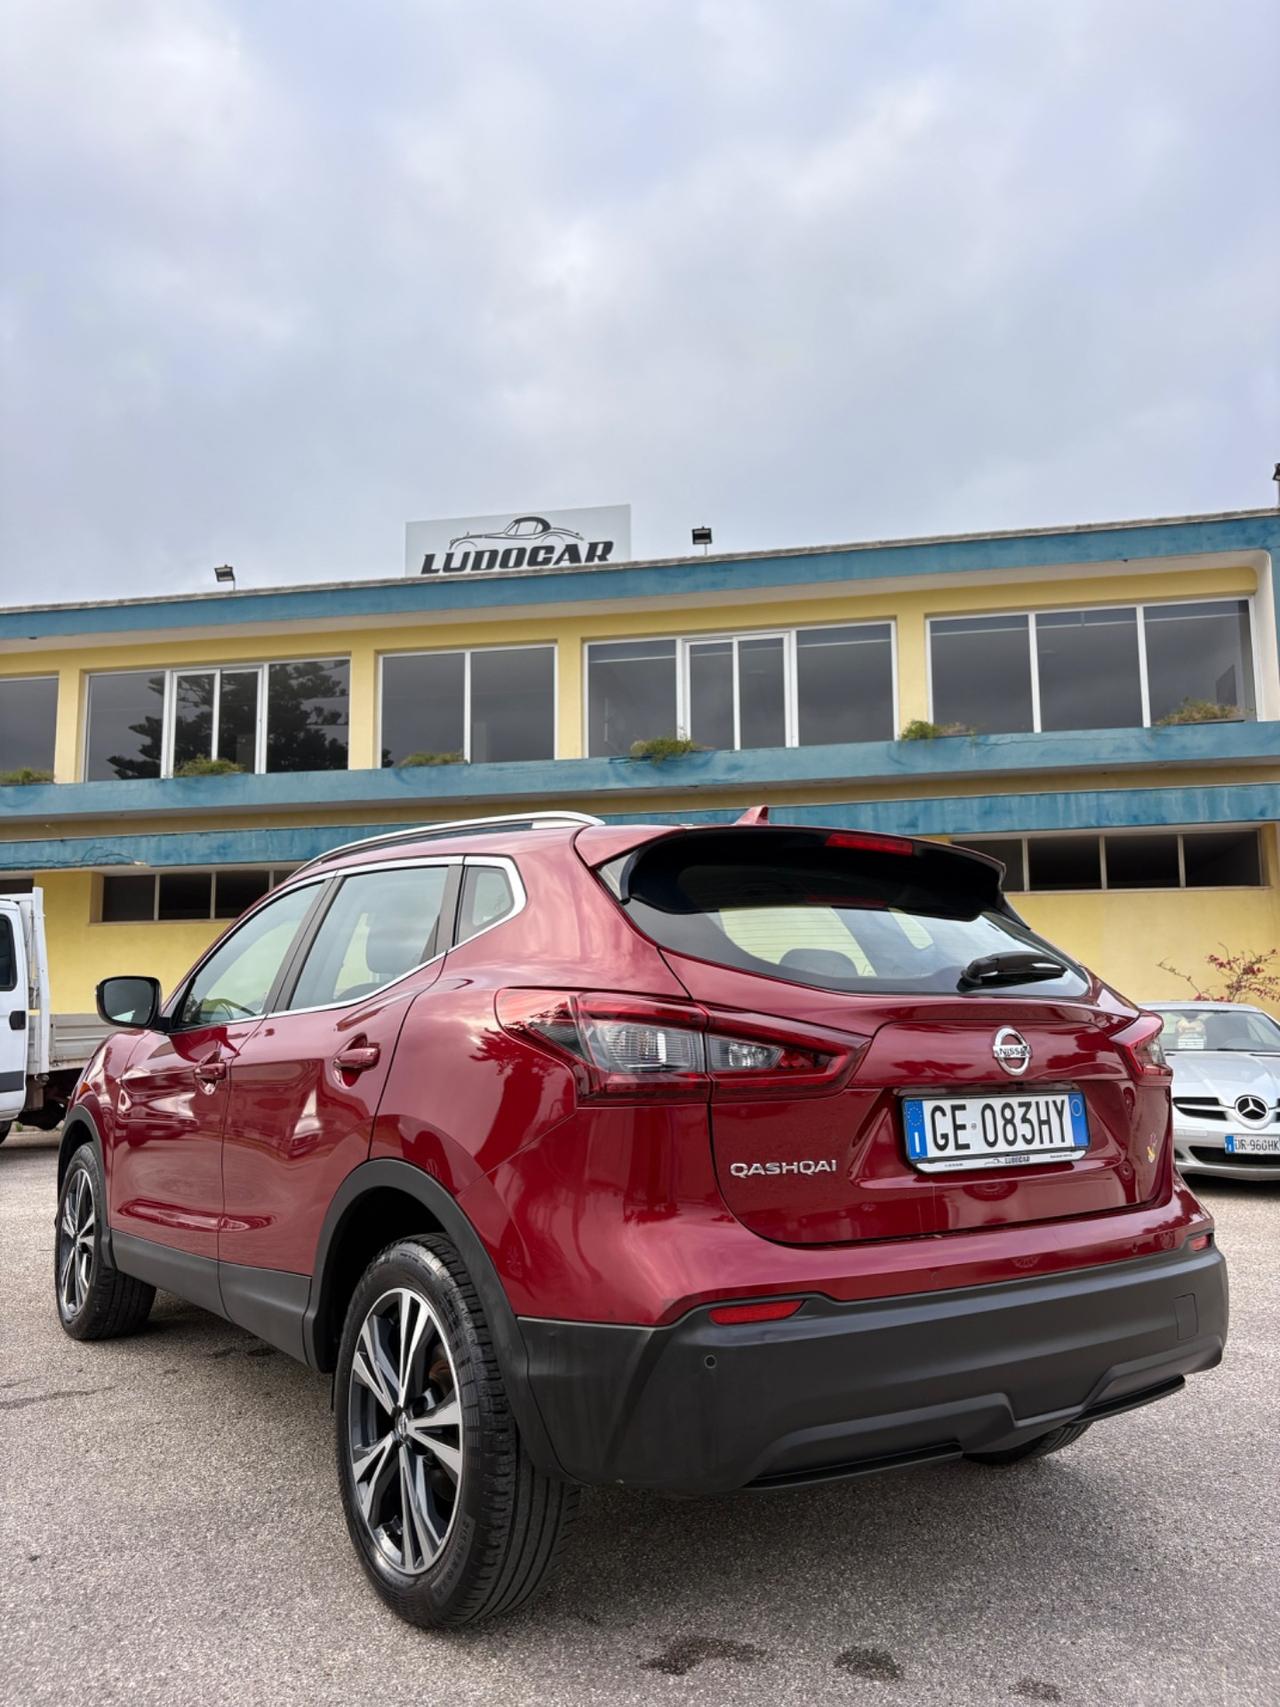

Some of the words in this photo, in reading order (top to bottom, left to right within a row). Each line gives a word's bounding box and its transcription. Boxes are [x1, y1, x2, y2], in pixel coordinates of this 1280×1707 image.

[421, 541, 614, 575] LUDOCAR
[981, 1099, 1066, 1148] 083HY
[730, 1160, 837, 1178] QASHQAI
